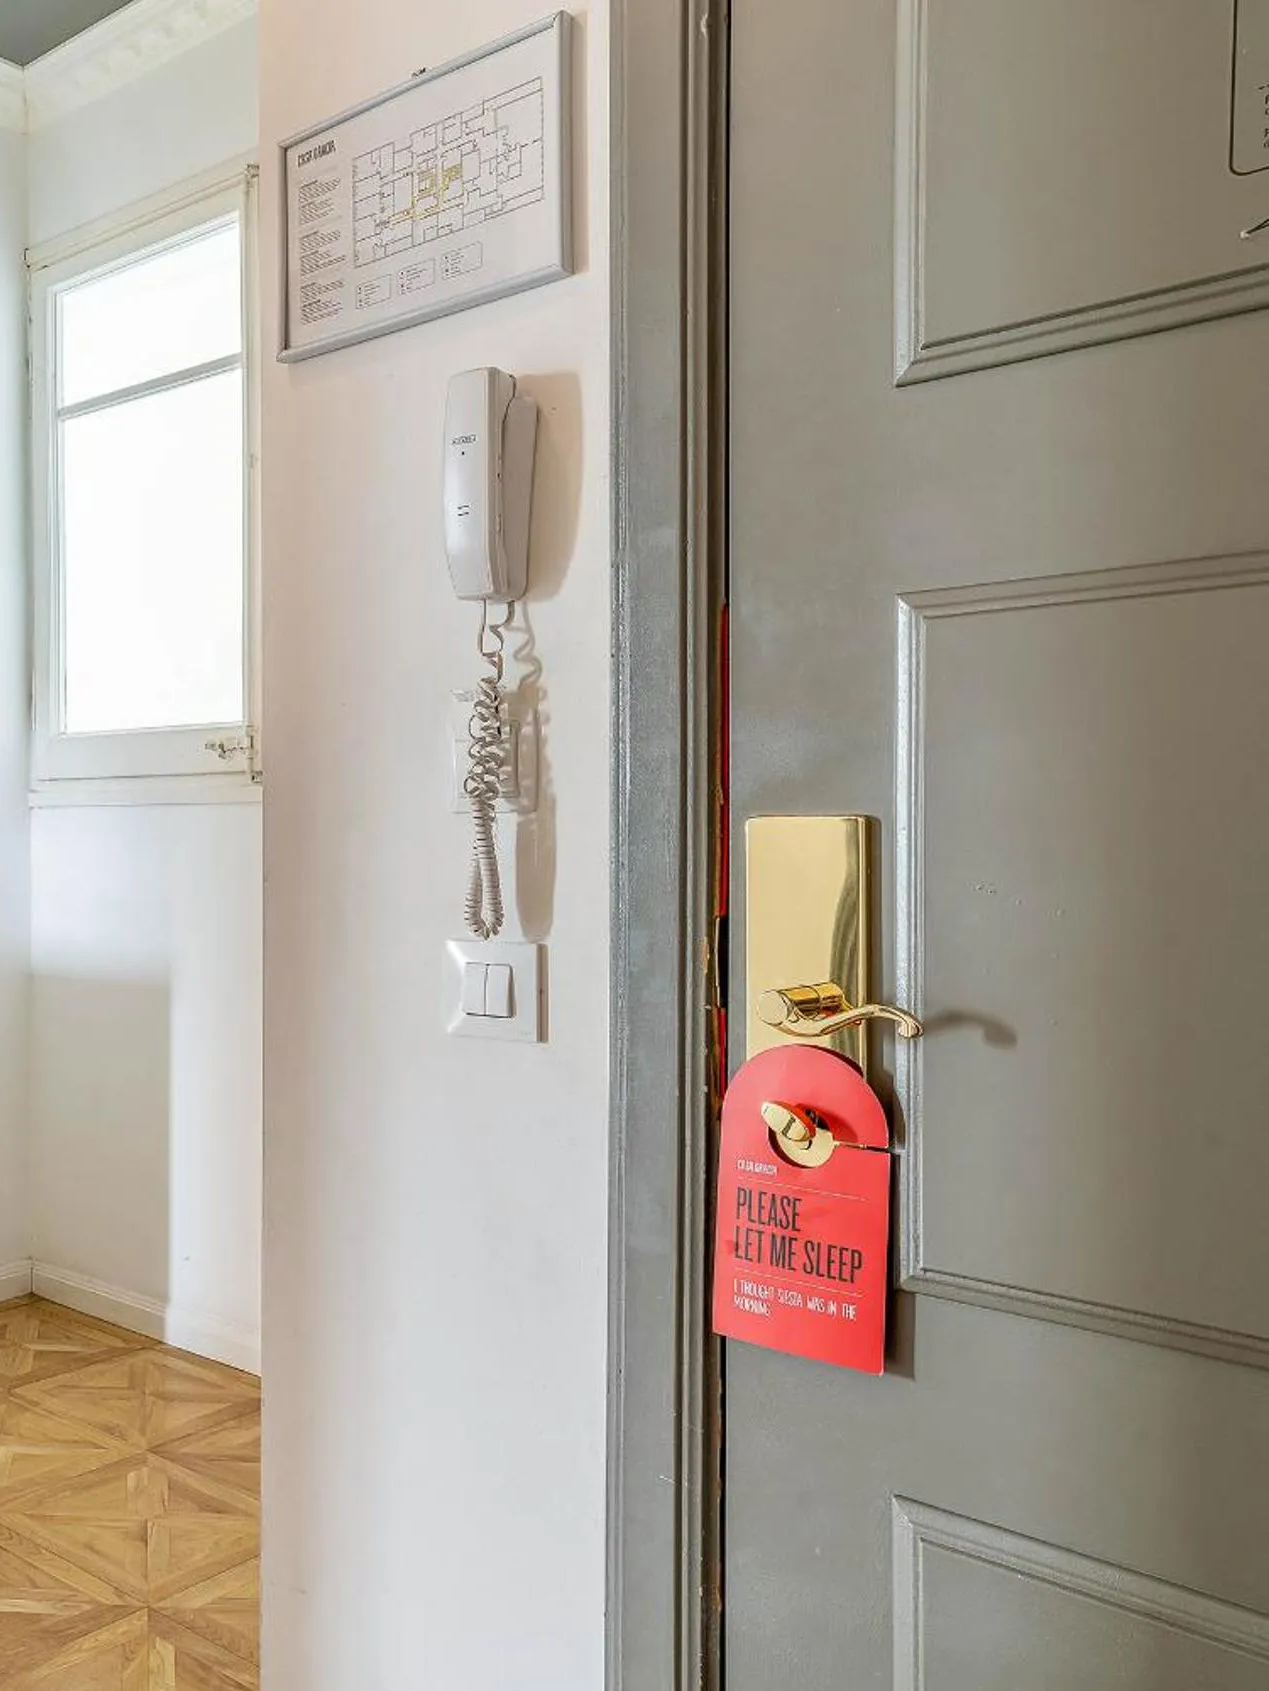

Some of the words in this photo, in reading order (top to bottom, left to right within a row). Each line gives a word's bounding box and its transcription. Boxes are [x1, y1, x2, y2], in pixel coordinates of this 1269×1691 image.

[736, 1186, 802, 1232] PLEASE
[734, 1226, 764, 1264] LET
[770, 1233, 798, 1272] ME
[802, 1240, 863, 1284] SLEEP
